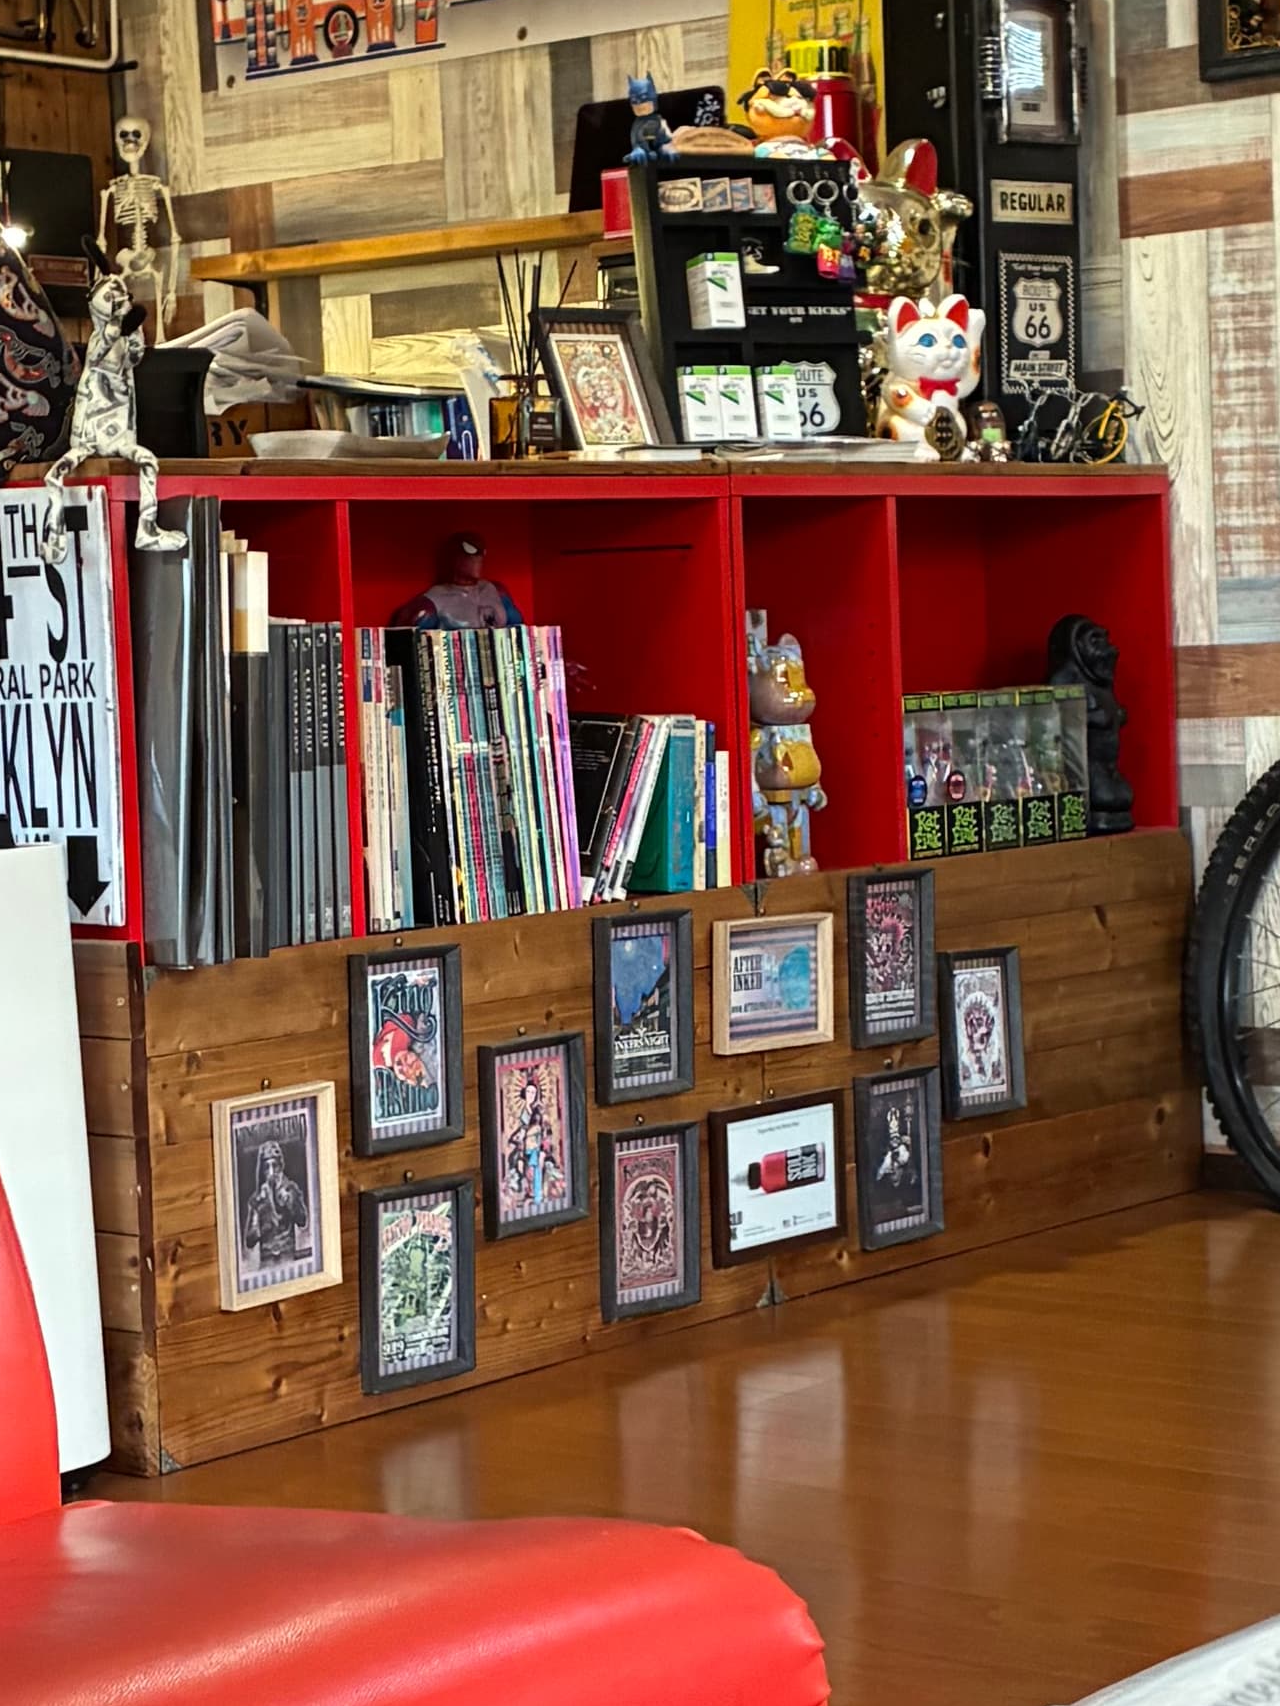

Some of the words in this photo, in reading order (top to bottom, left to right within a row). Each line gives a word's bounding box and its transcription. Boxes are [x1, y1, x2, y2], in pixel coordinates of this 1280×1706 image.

[999, 191, 1066, 213] REGULAR
[1022, 284, 1053, 297] ROUTE
[772, 307, 806, 316] YOUR
[1024, 315, 1051, 340] 66
[795, 369, 825, 383] OUTE
[39, 662, 97, 700] PARK
[733, 953, 763, 974] AFTER
[733, 972, 763, 993] INKED
